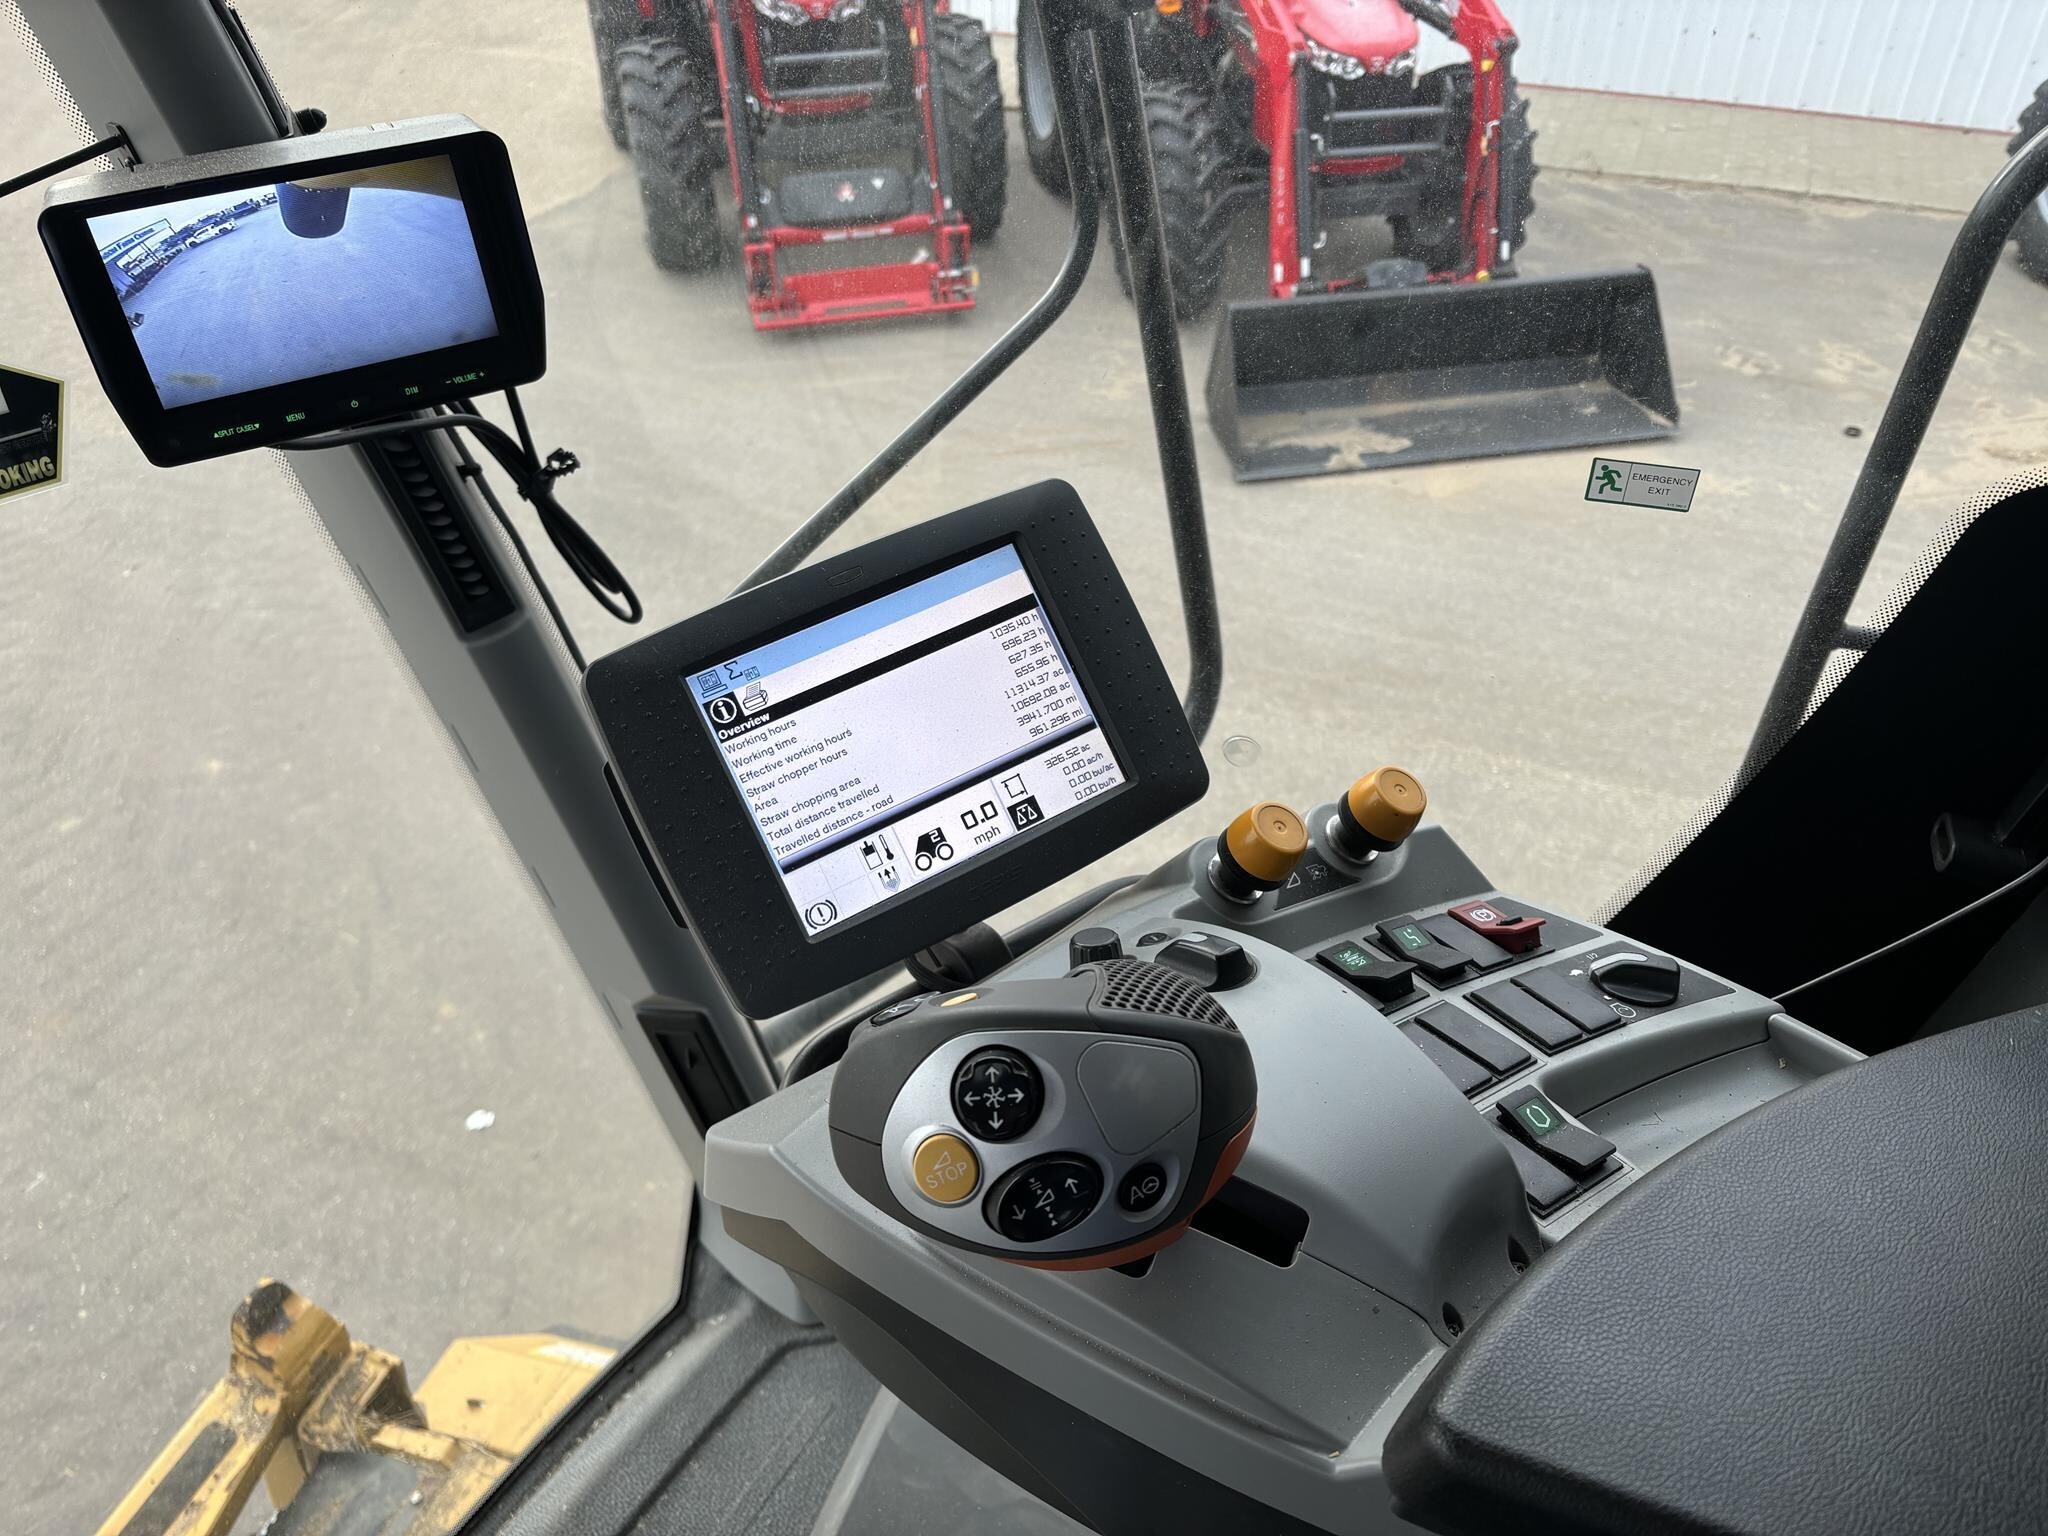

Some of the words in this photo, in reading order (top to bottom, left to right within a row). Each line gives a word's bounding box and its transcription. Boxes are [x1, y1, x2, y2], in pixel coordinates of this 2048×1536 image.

[405, 386, 419, 395] DIM
[452, 373, 478, 384] VOLUME
[286, 412, 305, 422] MENU
[1632, 473, 1693, 486] EMERGENCY
[1648, 487, 1671, 496] EXIT
[990, 616, 1031, 640] 1035.40
[1032, 613, 1039, 621] h
[1001, 630, 1037, 651] 696.23
[1038, 627, 1045, 635] h
[1008, 643, 1044, 664] 627.35
[1045, 640, 1051, 648] h
[1015, 656, 1050, 678] 655.96
[1051, 654, 1058, 662] h
[1004, 672, 1050, 699] 11314.37
[1053, 668, 1064, 678] ac
[1011, 686, 1058, 712] 10692.08
[1060, 682, 1071, 691] ac
[1016, 700, 1064, 727] 3941.700
[1065, 693, 1077, 704] mi
[1029, 714, 1071, 737] 961.296
[1072, 706, 1084, 718] mi
[718, 712, 770, 740] Overview
[724, 730, 768, 754] Working
[768, 719, 797, 738] hours
[732, 746, 775, 768] Working
[775, 736, 797, 750] time
[739, 761, 784, 784] Effective
[785, 743, 824, 763] working
[824, 729, 852, 746] hours
[1044, 746, 1080, 769] 326.52
[1081, 744, 1090, 752] ac
[1062, 759, 1086, 775] 0.00
[1087, 753, 1104, 764] ac/h
[746, 781, 776, 798] Straw
[778, 762, 818, 785] chopper
[819, 749, 848, 765] hours
[1069, 771, 1092, 788] 0.00
[1092, 763, 1114, 777] bu/ac
[1075, 784, 1098, 800] 0.00
[1098, 777, 1116, 790] bu/h
[754, 797, 778, 813] Area
[760, 810, 789, 827] Straw
[791, 788, 838, 813] chopping
[839, 777, 861, 792] area
[767, 824, 792, 841] Total
[794, 807, 836, 828] distance
[837, 784, 880, 809] travelled
[773, 829, 820, 856] Travelled
[823, 811, 864, 834] distance
[872, 795, 894, 812] road
[960, 800, 999, 830] 0.0
[929, 830, 940, 842] 2
[974, 826, 1000, 845] mph
[927, 1162, 967, 1188] STOP
